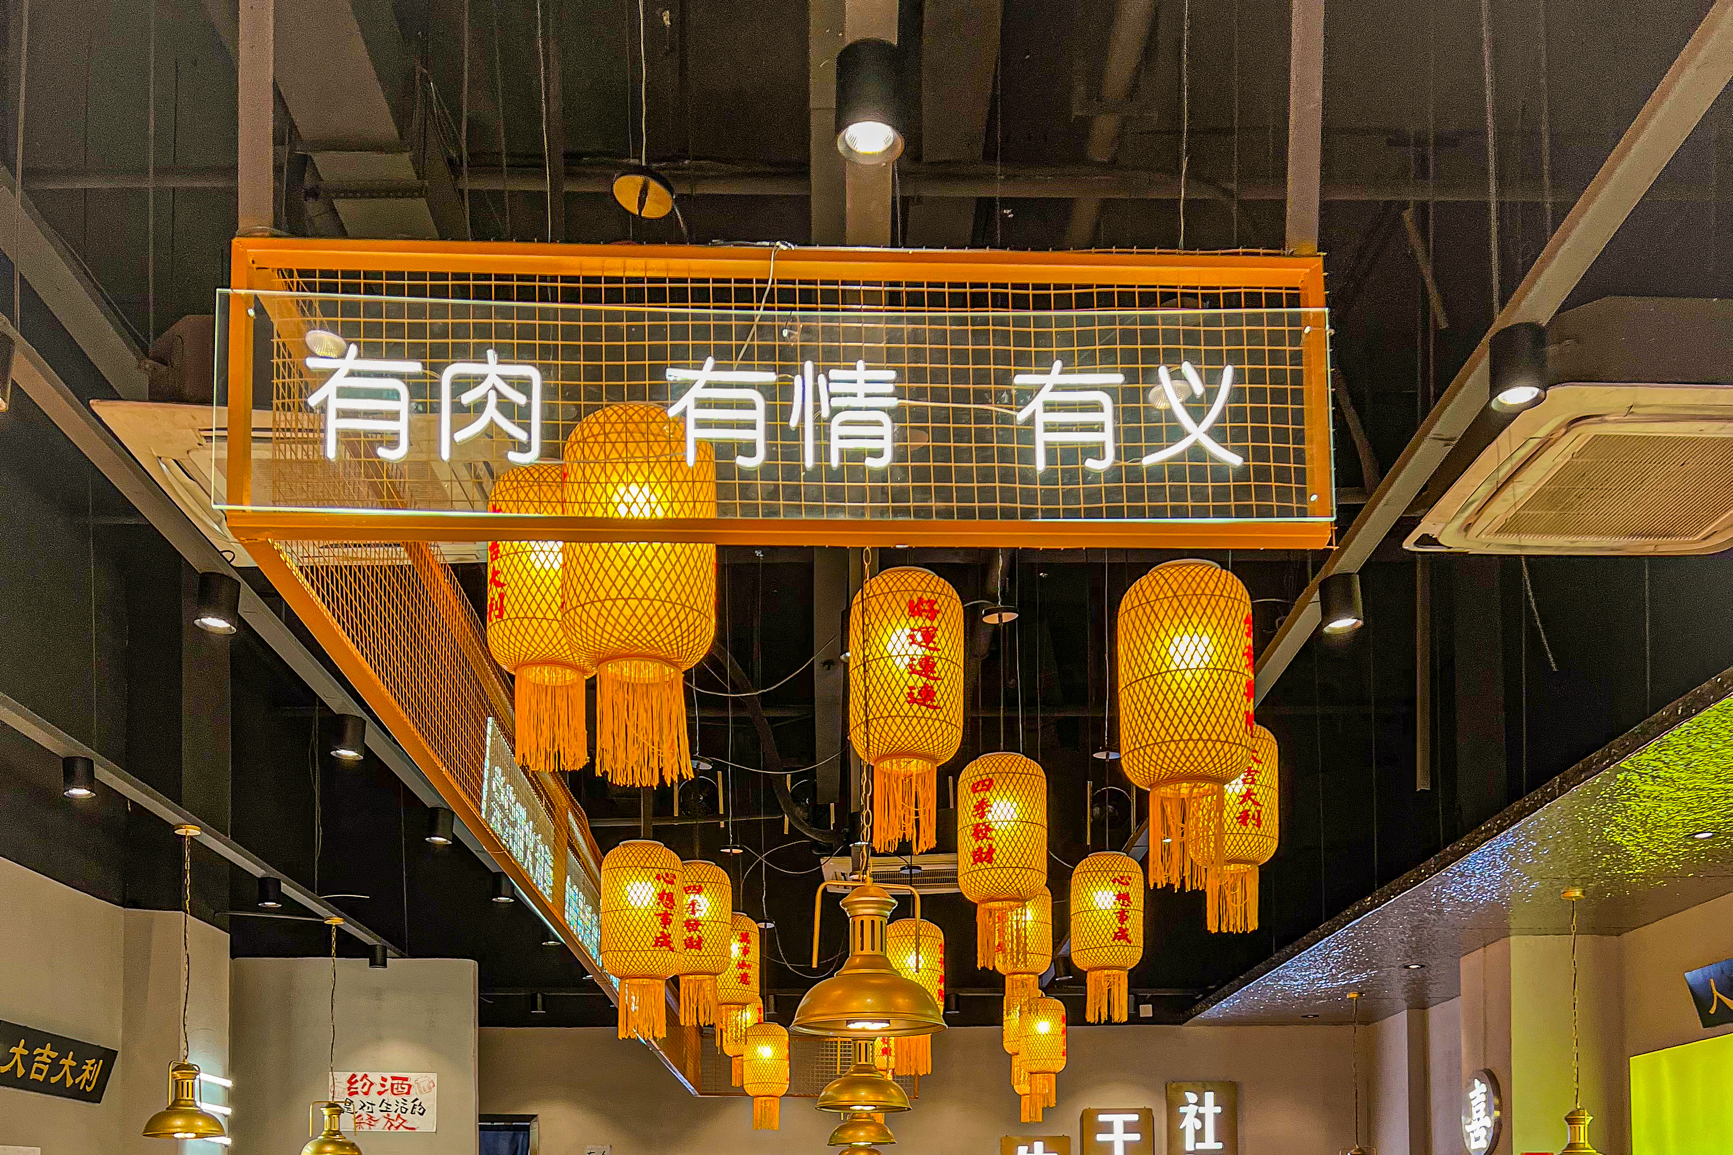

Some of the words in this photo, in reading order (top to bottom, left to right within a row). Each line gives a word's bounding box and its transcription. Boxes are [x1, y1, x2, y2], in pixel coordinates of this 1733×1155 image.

[306, 346, 541, 465] 有肉
[667, 355, 899, 471] 有情
[1013, 359, 1243, 473] 有义
[652, 872, 677, 952] 心想事成
[1111, 875, 1133, 945] 心想事成
[0, 1038, 104, 1093] 大吉大利
[355, 1113, 417, 1132] 释放
[1464, 1078, 1493, 1150] 喜
